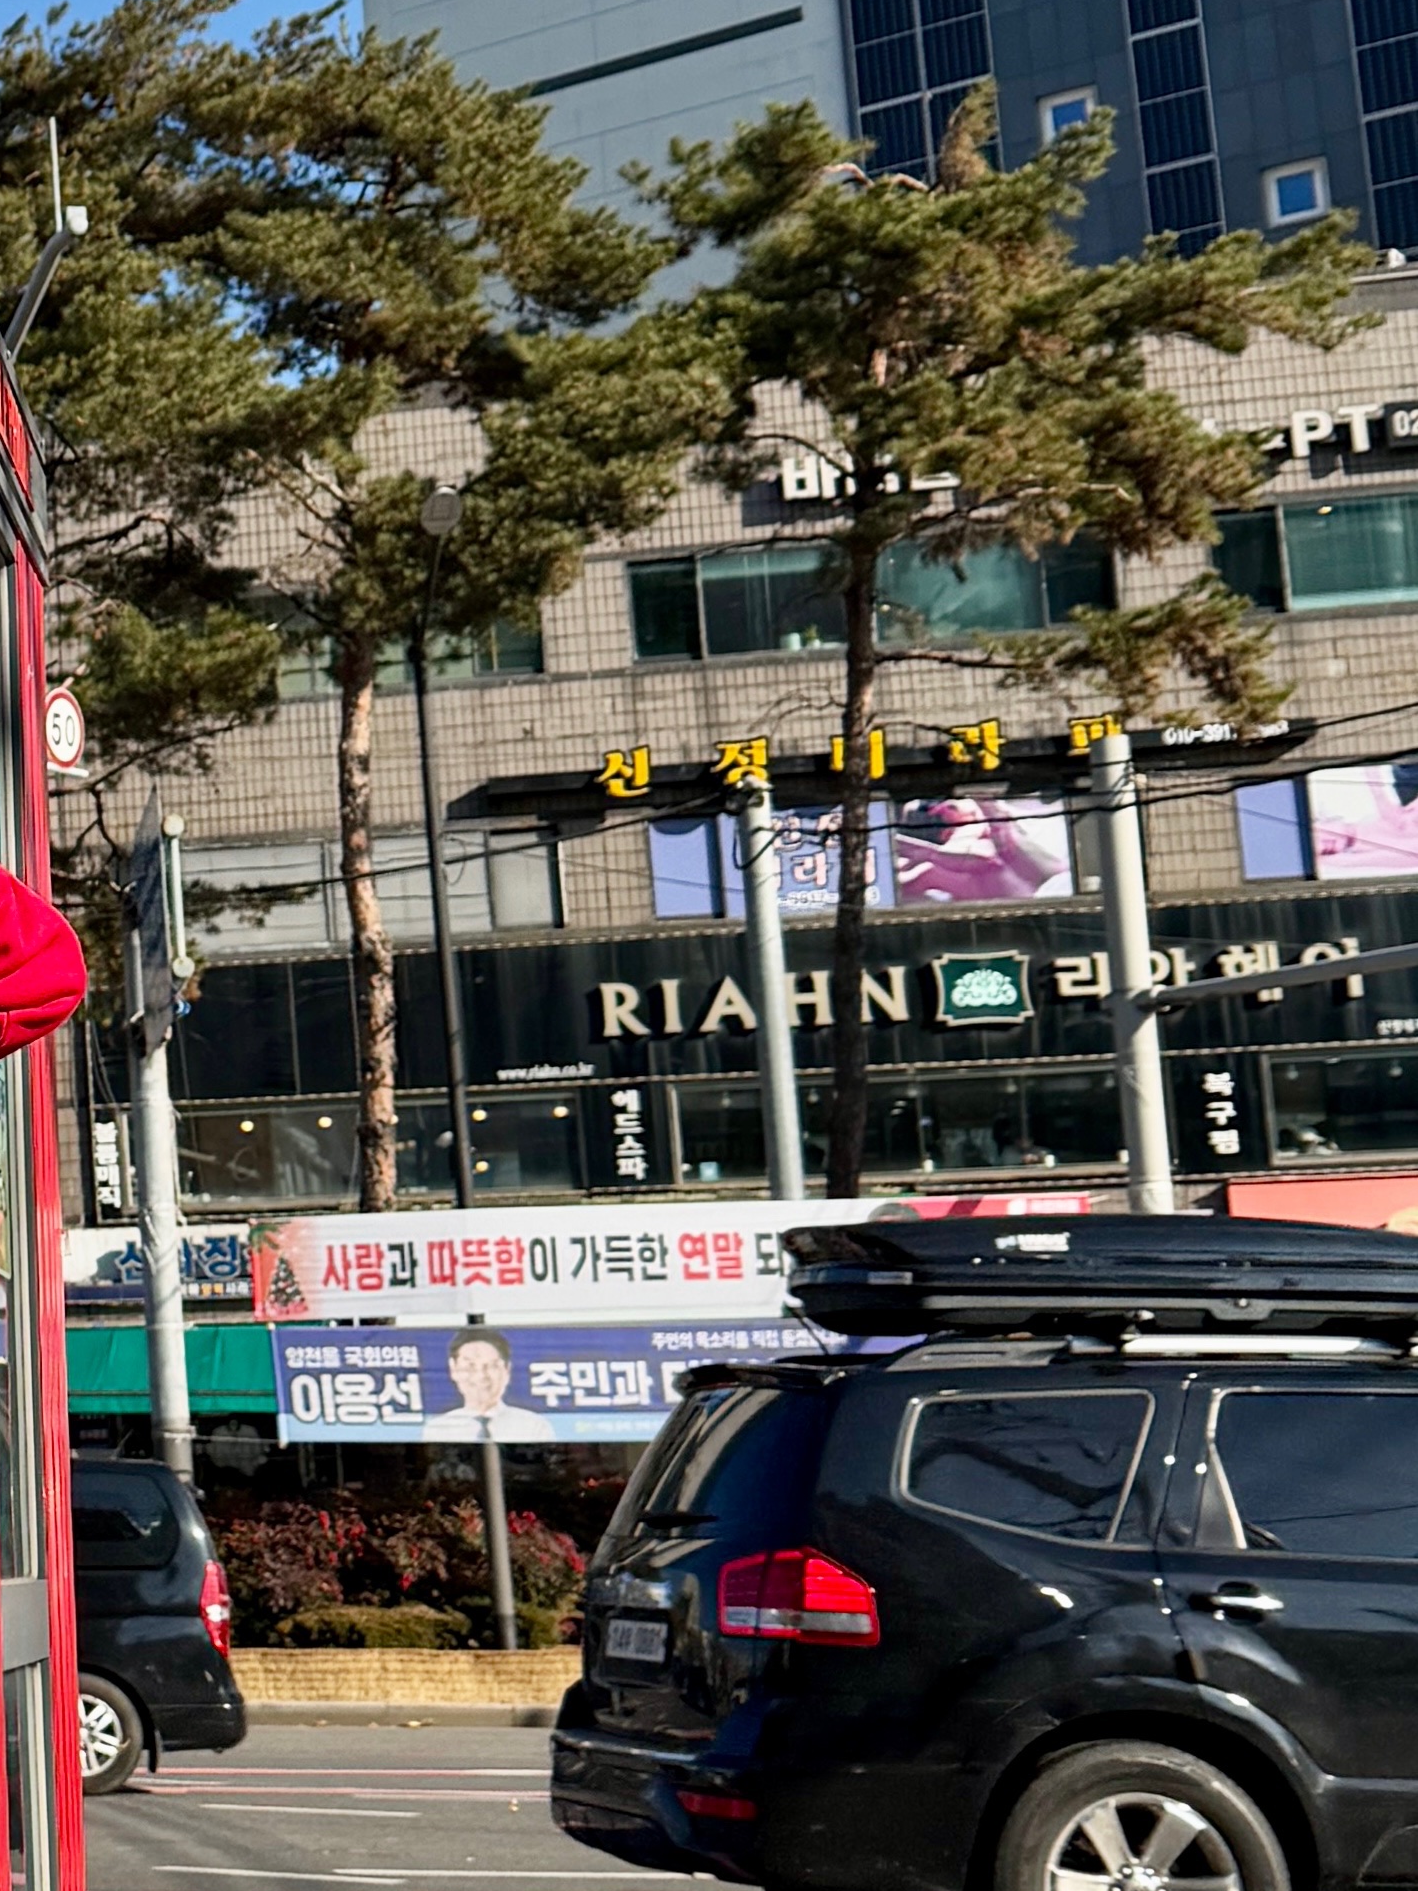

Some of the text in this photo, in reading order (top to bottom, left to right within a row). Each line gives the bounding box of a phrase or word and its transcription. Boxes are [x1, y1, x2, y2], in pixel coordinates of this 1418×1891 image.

[51, 711, 76, 747] 50
[600, 965, 909, 1038] RIAHN
[321, 1240, 419, 1292] 사랑과
[427, 1234, 561, 1287] 따뜻함이
[569, 1232, 670, 1284] 가득한
[677, 1229, 744, 1281] 연말
[285, 1344, 420, 1369] 양천을 국회의원
[290, 1372, 424, 1426] 이용선
[528, 1360, 655, 1408] 주민과
